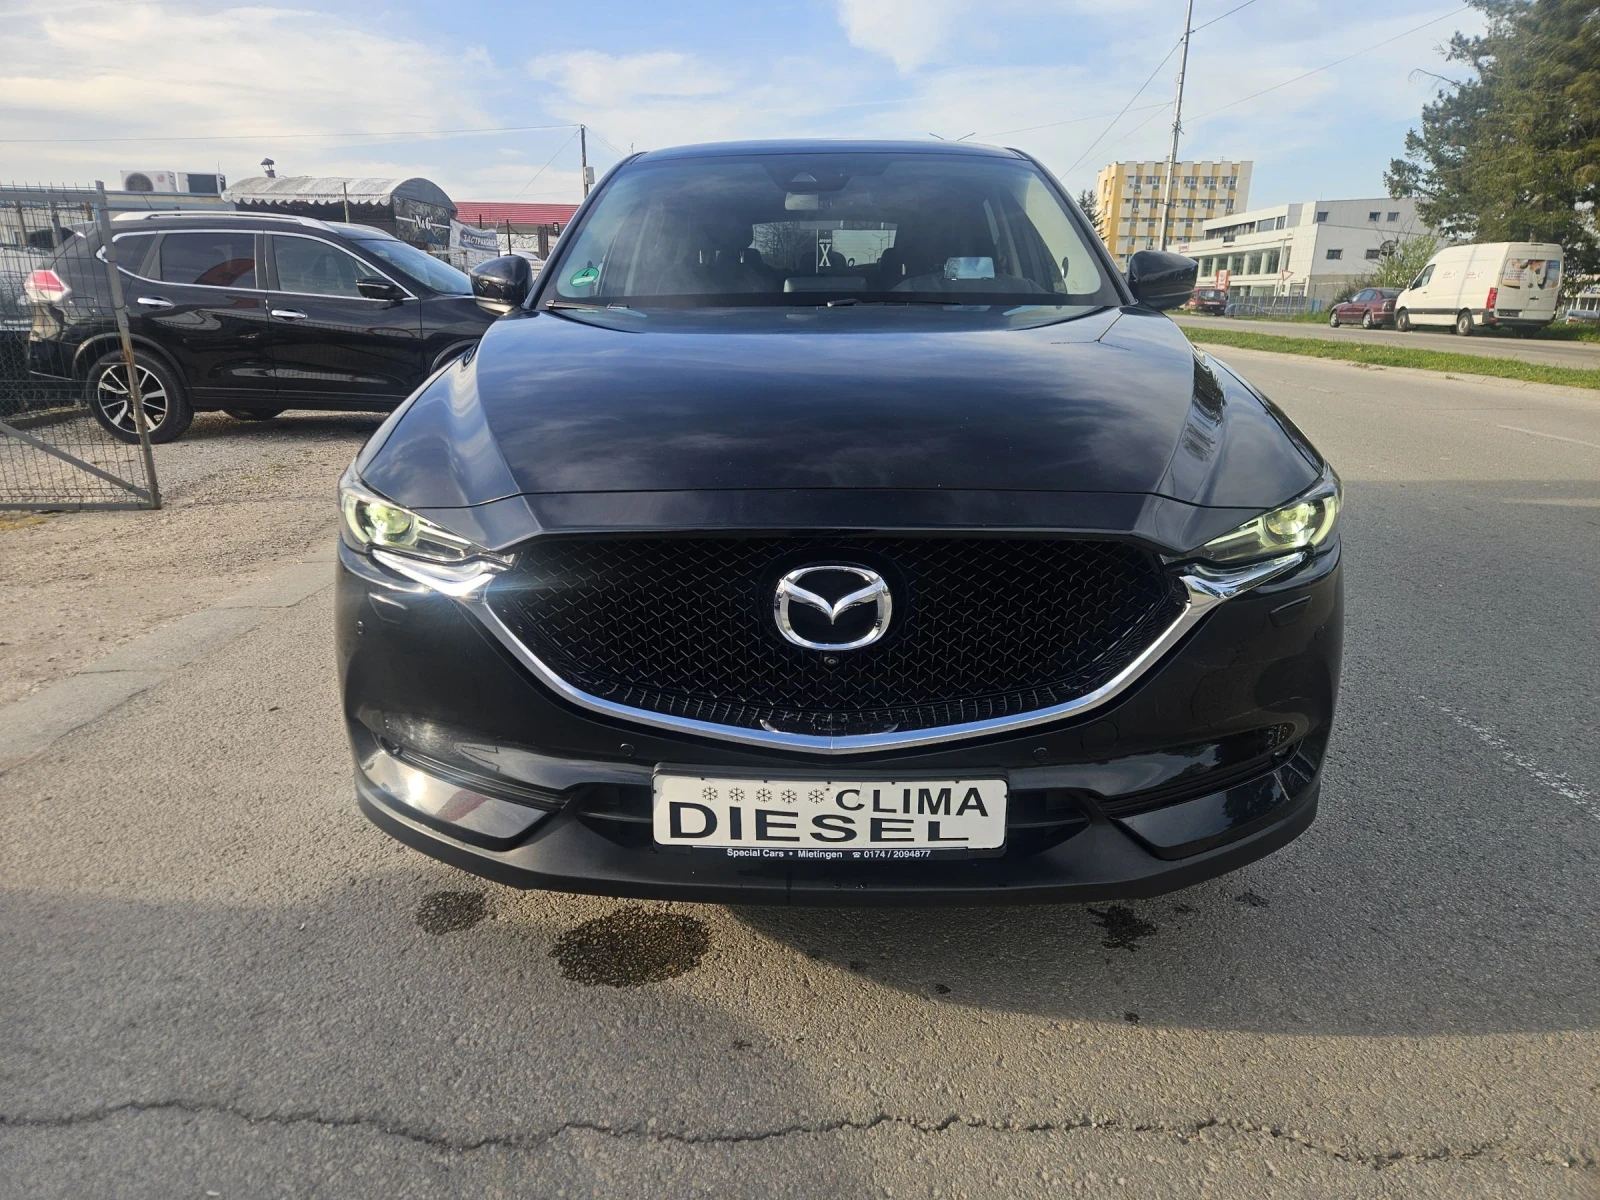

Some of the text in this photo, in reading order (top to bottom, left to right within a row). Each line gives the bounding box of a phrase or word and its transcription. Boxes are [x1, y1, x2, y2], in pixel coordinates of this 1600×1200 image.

[818, 243, 832, 267] X
[581, 268, 590, 277] 4
[835, 787, 989, 817] CLIMA
[668, 801, 970, 843] DIESEL
[726, 848, 760, 858] Special
[762, 849, 785, 858] Cars
[797, 850, 843, 860] Mietingen
[863, 850, 886, 858] 0174
[893, 850, 931, 858] 2094877
